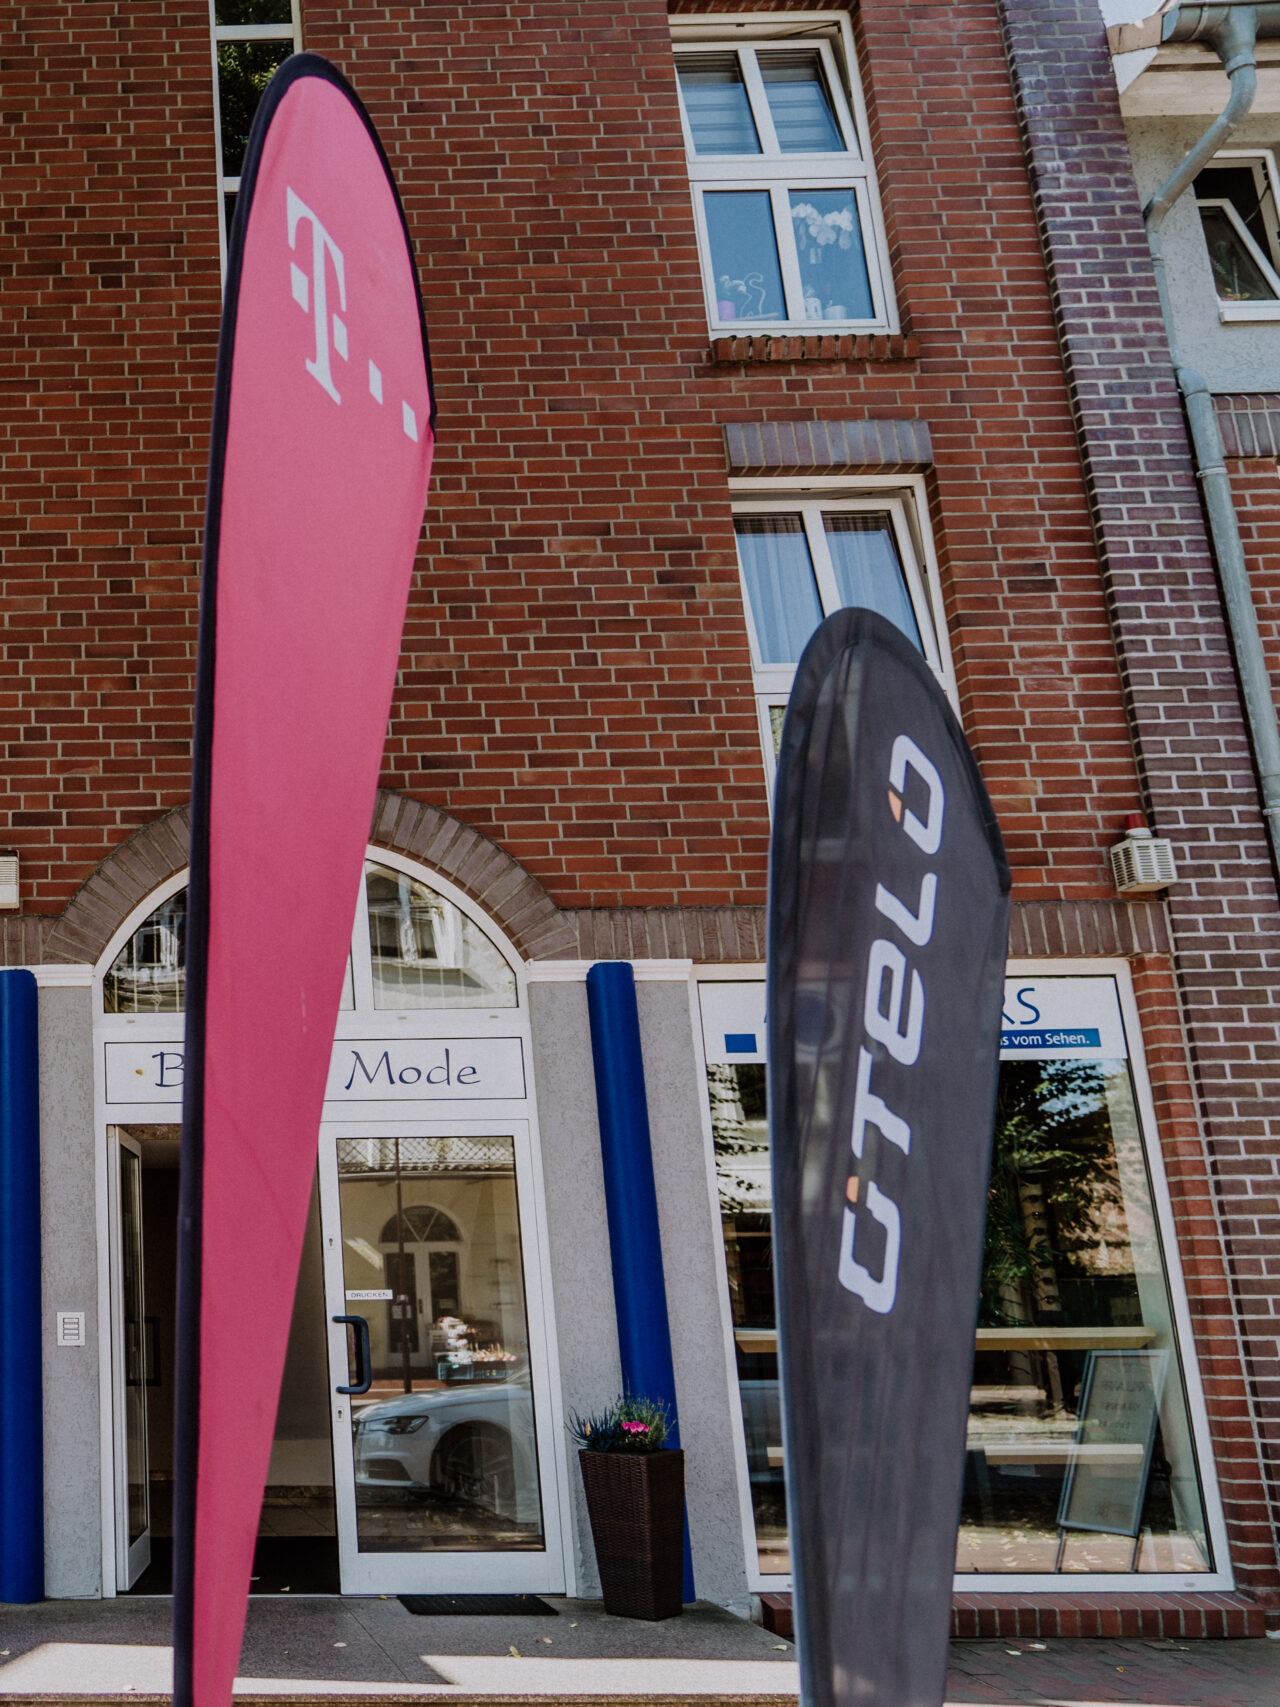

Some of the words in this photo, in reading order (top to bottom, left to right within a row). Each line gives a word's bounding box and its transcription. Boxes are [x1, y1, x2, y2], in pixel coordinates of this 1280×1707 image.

[1012, 1035, 1042, 1046] vom
[1045, 1032, 1090, 1045] Sehen.
[344, 1048, 482, 1091] Mode
[350, 1291, 389, 1299] DRUCKEN
